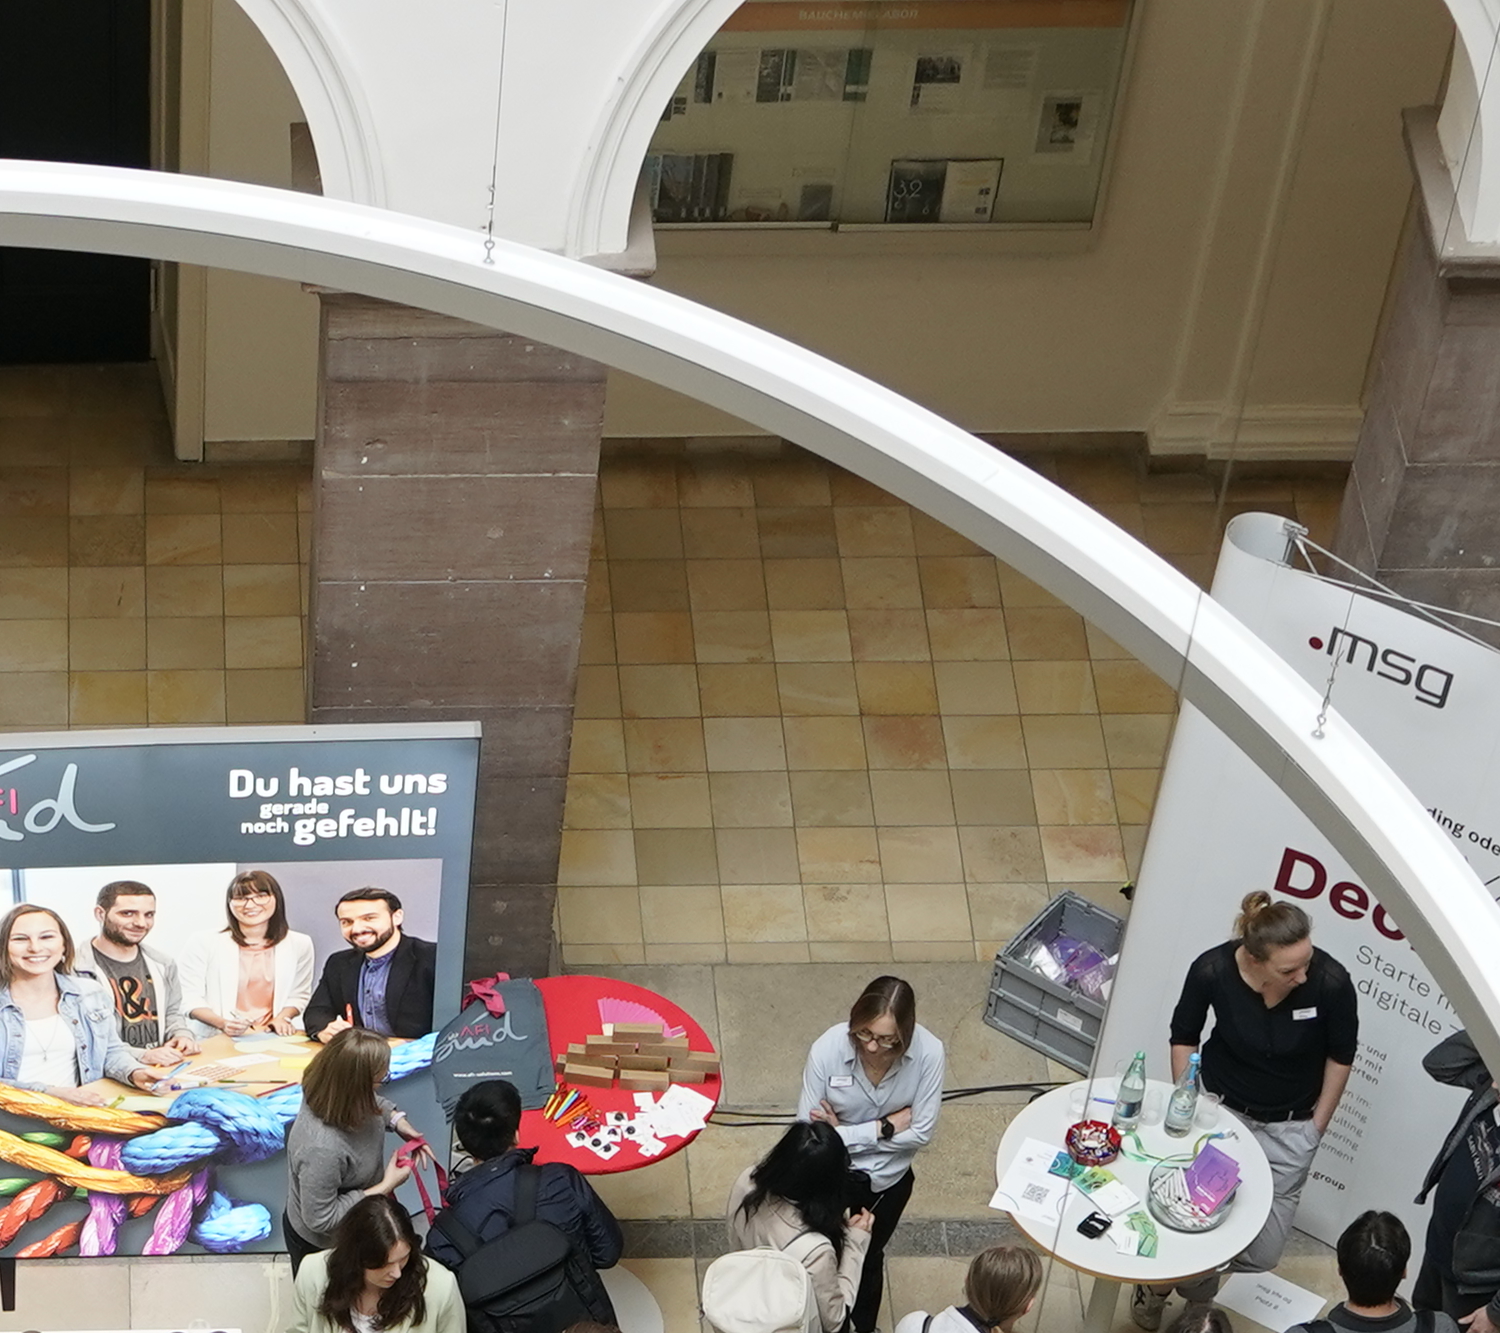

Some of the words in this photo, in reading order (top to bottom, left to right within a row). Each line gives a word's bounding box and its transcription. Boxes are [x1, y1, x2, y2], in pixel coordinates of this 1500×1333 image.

[1308, 626, 1454, 709] .msg
[229, 769, 279, 798] Du
[289, 767, 371, 796] hast
[379, 772, 448, 795] uns
[259, 798, 329, 819] gerade
[241, 817, 289, 834] noch
[293, 807, 438, 845] gefehlt!
[1355, 943, 1432, 999] Starte
[1357, 977, 1443, 1036] digitale
[1365, 1057, 1384, 1075] mit
[1366, 1042, 1388, 1062] und
